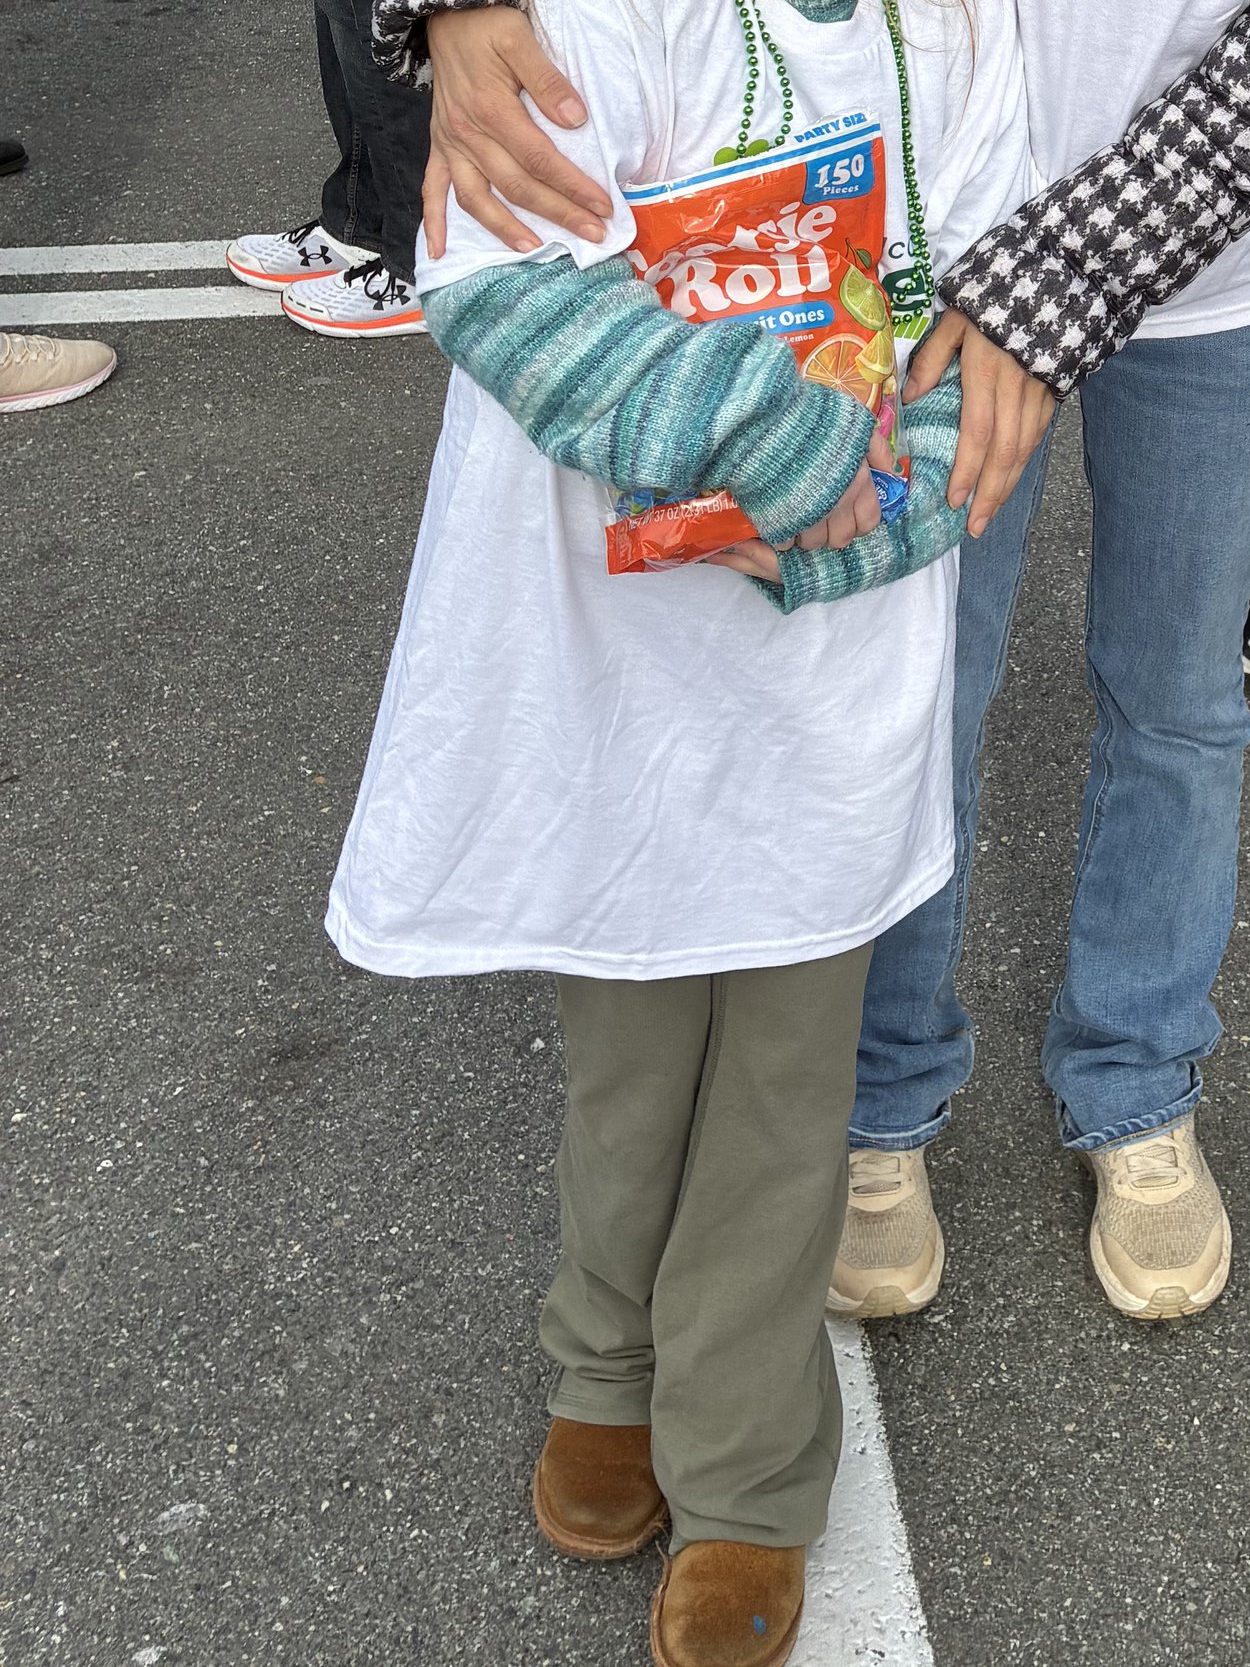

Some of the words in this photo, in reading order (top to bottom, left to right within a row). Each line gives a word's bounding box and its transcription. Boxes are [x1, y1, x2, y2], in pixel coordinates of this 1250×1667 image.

[794, 119, 841, 143] PARTY
[843, 112, 868, 128] SIZ
[815, 153, 865, 188] 150
[823, 185, 860, 196] Pieces
[661, 245, 833, 318] Roll
[779, 309, 826, 327] Ones
[654, 509, 665, 523] 37
[666, 506, 680, 520] OZ
